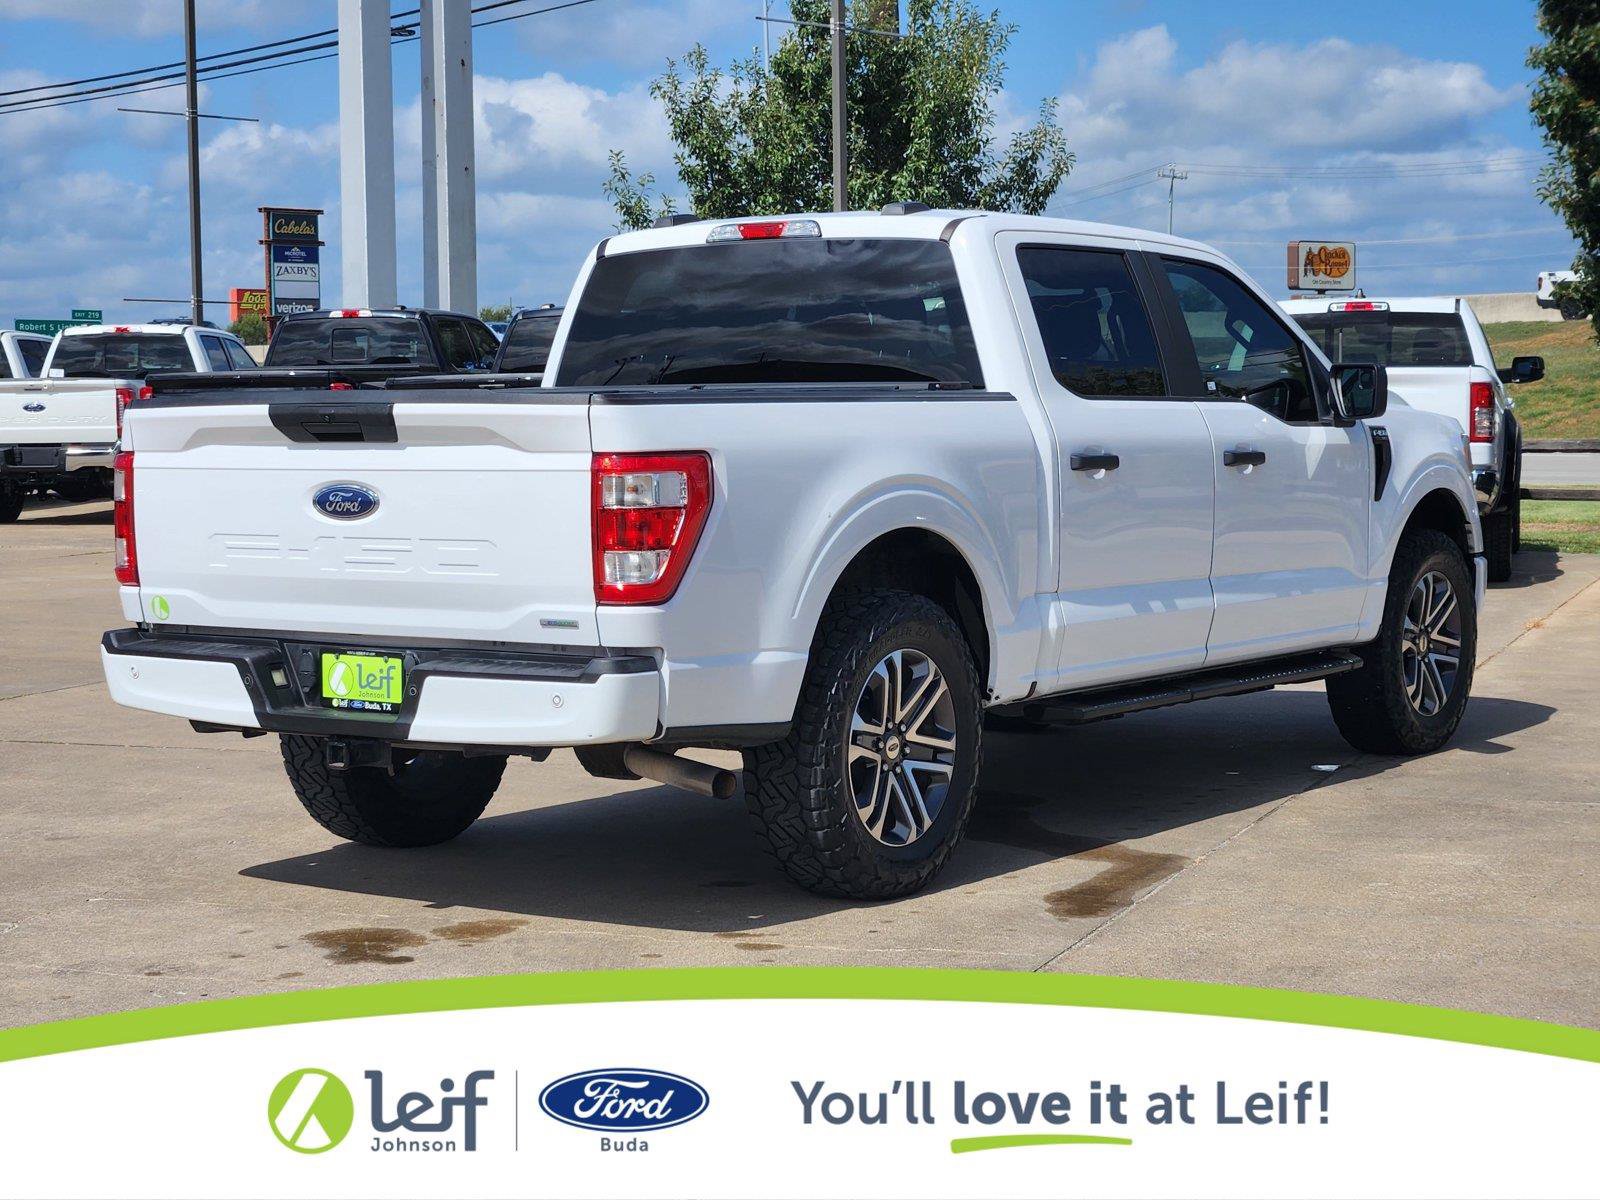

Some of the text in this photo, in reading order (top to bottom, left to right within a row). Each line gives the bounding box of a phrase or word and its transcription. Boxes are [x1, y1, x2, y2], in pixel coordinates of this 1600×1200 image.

[274, 218, 316, 235] Cabela's
[276, 265, 317, 277] ZAXBY'S
[19, 323, 46, 331] Robert
[325, 491, 362, 513] Ford
[356, 662, 396, 699] leif
[358, 691, 385, 699] Johnson
[382, 703, 392, 711] TX
